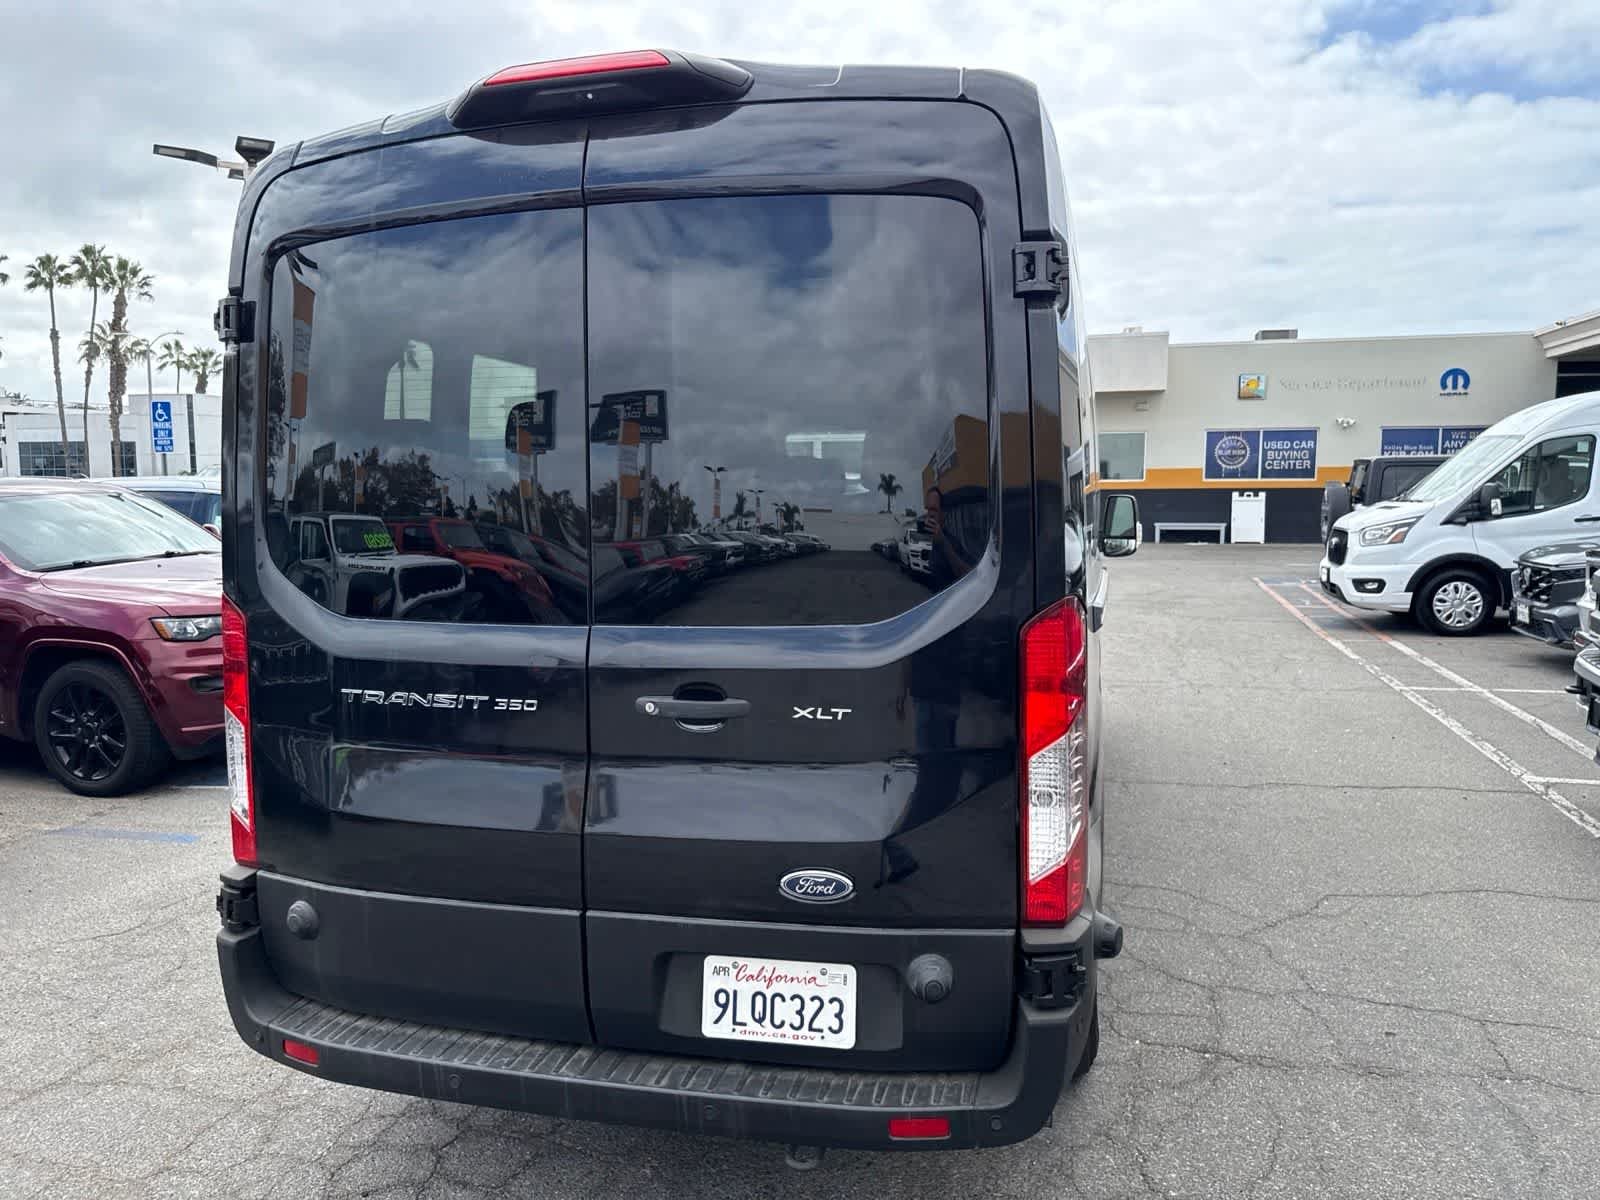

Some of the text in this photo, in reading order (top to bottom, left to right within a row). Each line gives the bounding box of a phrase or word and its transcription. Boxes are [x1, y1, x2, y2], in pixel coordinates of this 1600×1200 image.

[1337, 375, 1427, 393] Department
[1263, 440, 1314, 450] USED CAR
[1443, 440, 1465, 449] ANY
[1266, 450, 1309, 460] BUYING
[1264, 459, 1311, 470] CENTER
[340, 688, 538, 711] TRANSIT 350
[792, 706, 852, 721] XLT
[795, 877, 836, 895] Ford
[712, 965, 730, 977] APR
[735, 963, 828, 990] California
[713, 987, 845, 1035] 9LQC323
[739, 1028, 817, 1041] dmv.ca.gov
